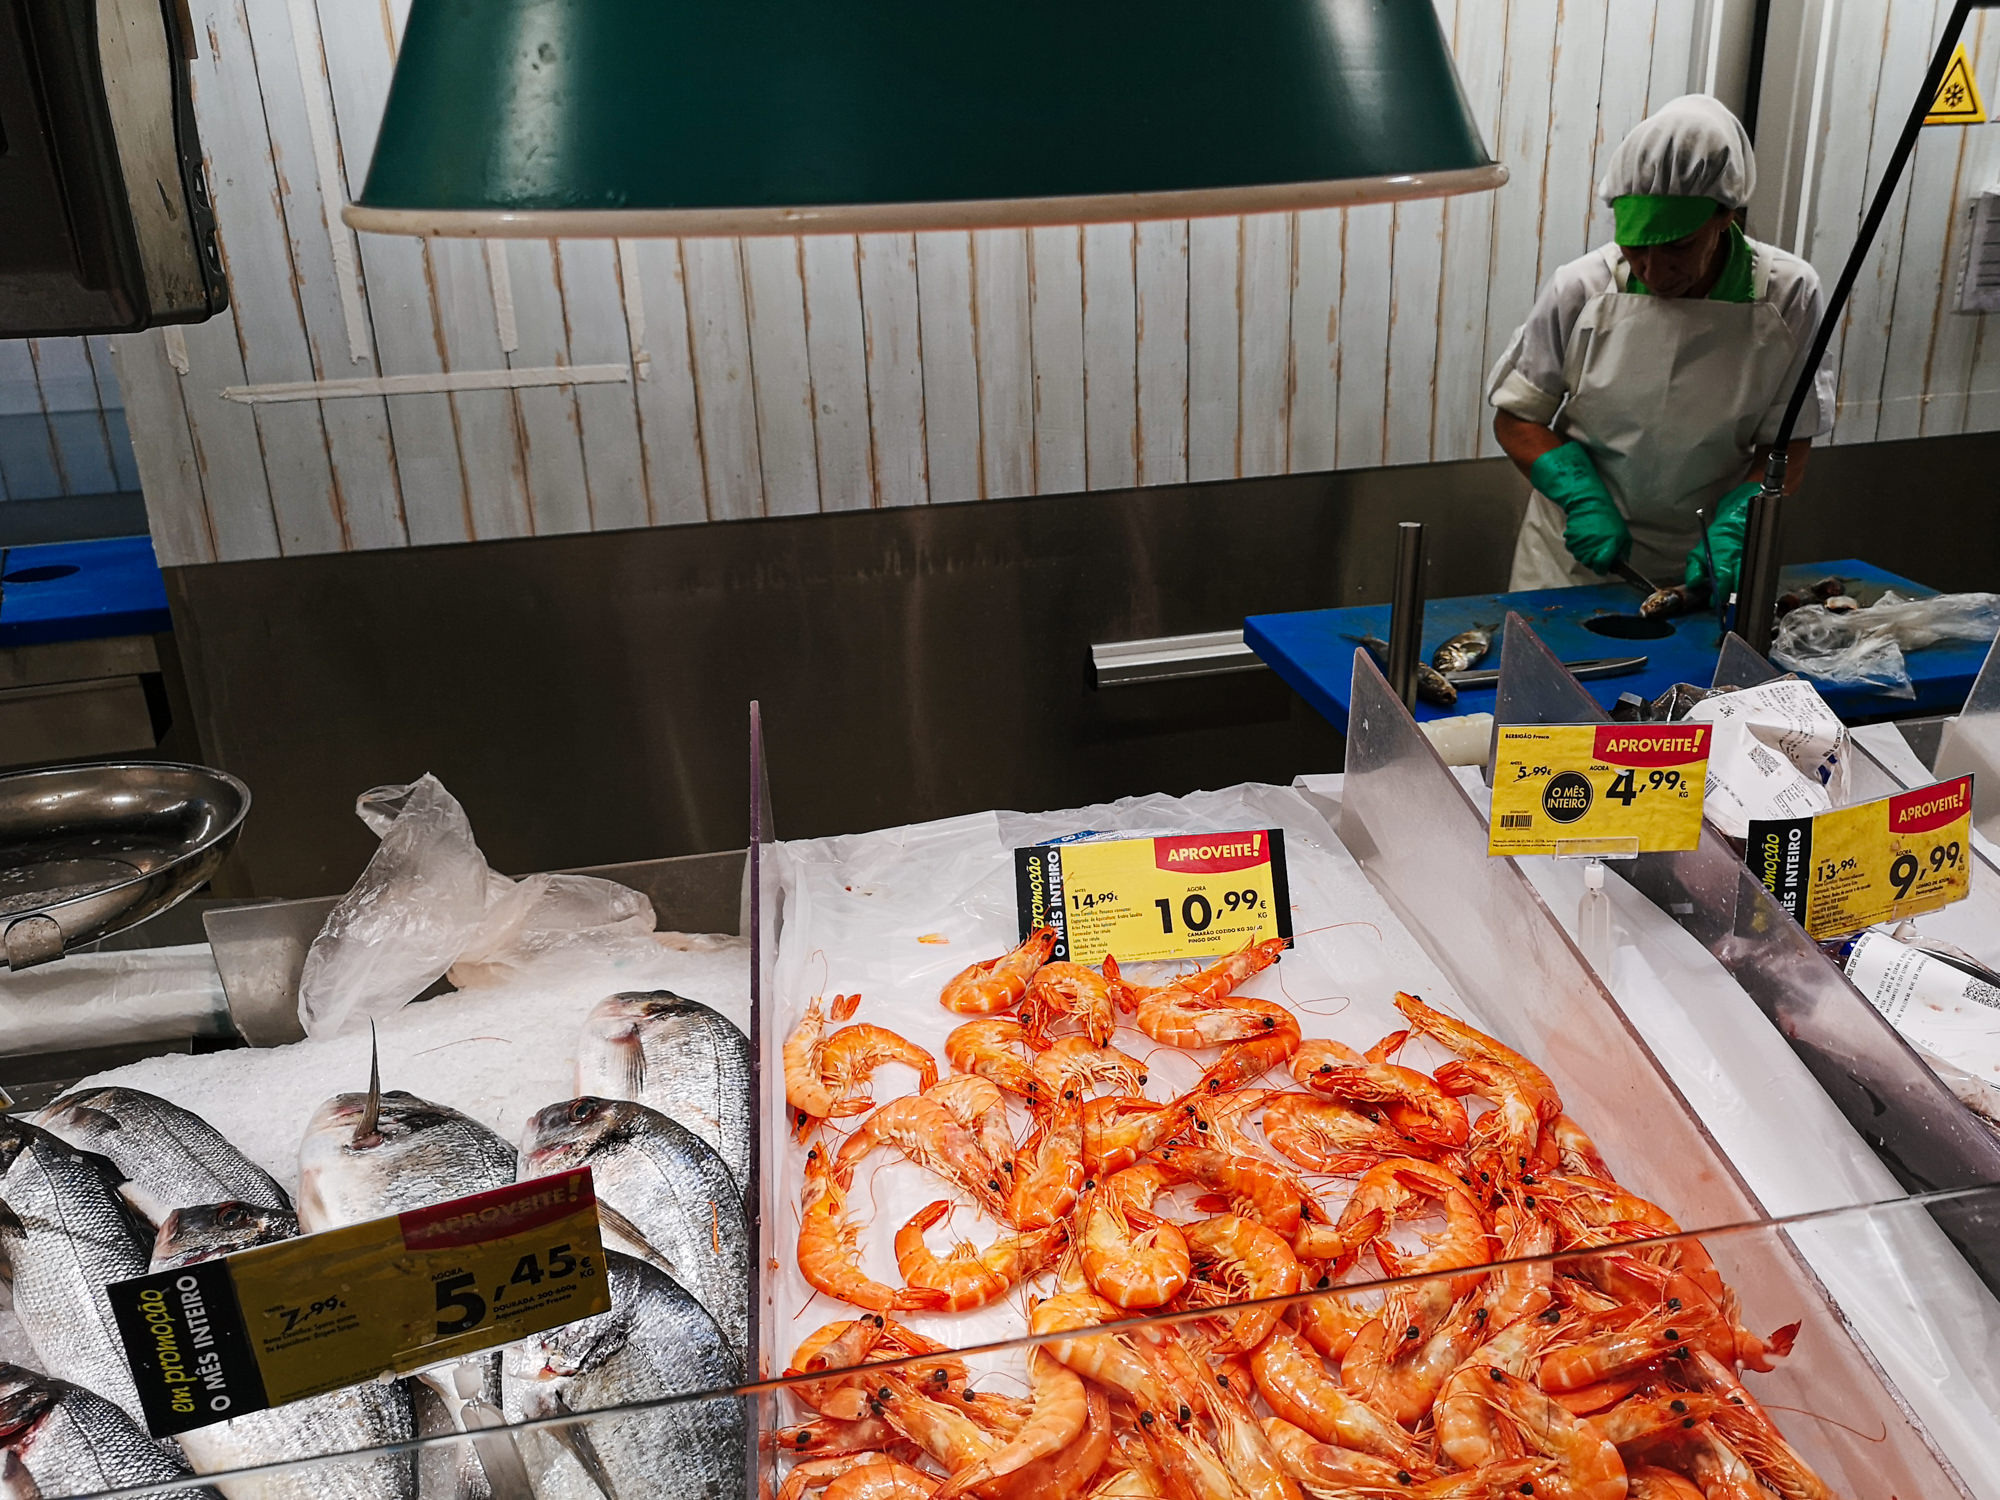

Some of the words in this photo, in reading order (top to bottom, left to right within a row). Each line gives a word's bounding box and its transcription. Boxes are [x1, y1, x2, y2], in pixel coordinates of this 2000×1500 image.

[1606, 728, 1704, 753] APROVEITE!
[1547, 798, 1587, 809] INTEIRO
[1552, 787, 1561, 798] O
[1563, 785, 1585, 798] MÊS
[1606, 769, 1687, 806] 4,99€
[1898, 783, 1966, 824] APROVEITE!
[1167, 834, 1261, 862] APROVEITE!
[1762, 834, 1780, 892] omoção
[1785, 828, 1801, 887] INTEIRO
[1047, 851, 1062, 906] INTEIRO
[1154, 889, 1267, 934] 10,99€
[1187, 930, 1214, 938] CAMARÃO
[1055, 944, 1065, 957] O
[426, 1175, 582, 1238] APROVEITE!
[431, 1267, 463, 1281] AGORA
[436, 1244, 592, 1335] 5,45€
[579, 1268, 595, 1279] KG
[176, 1275, 215, 1349] INTEIRO
[493, 1296, 535, 1313] DOURADA
[137, 1289, 198, 1384] promoção
[194, 1352, 227, 1390] MÊS
[171, 1386, 195, 1412] em
[210, 1395, 231, 1411] O
